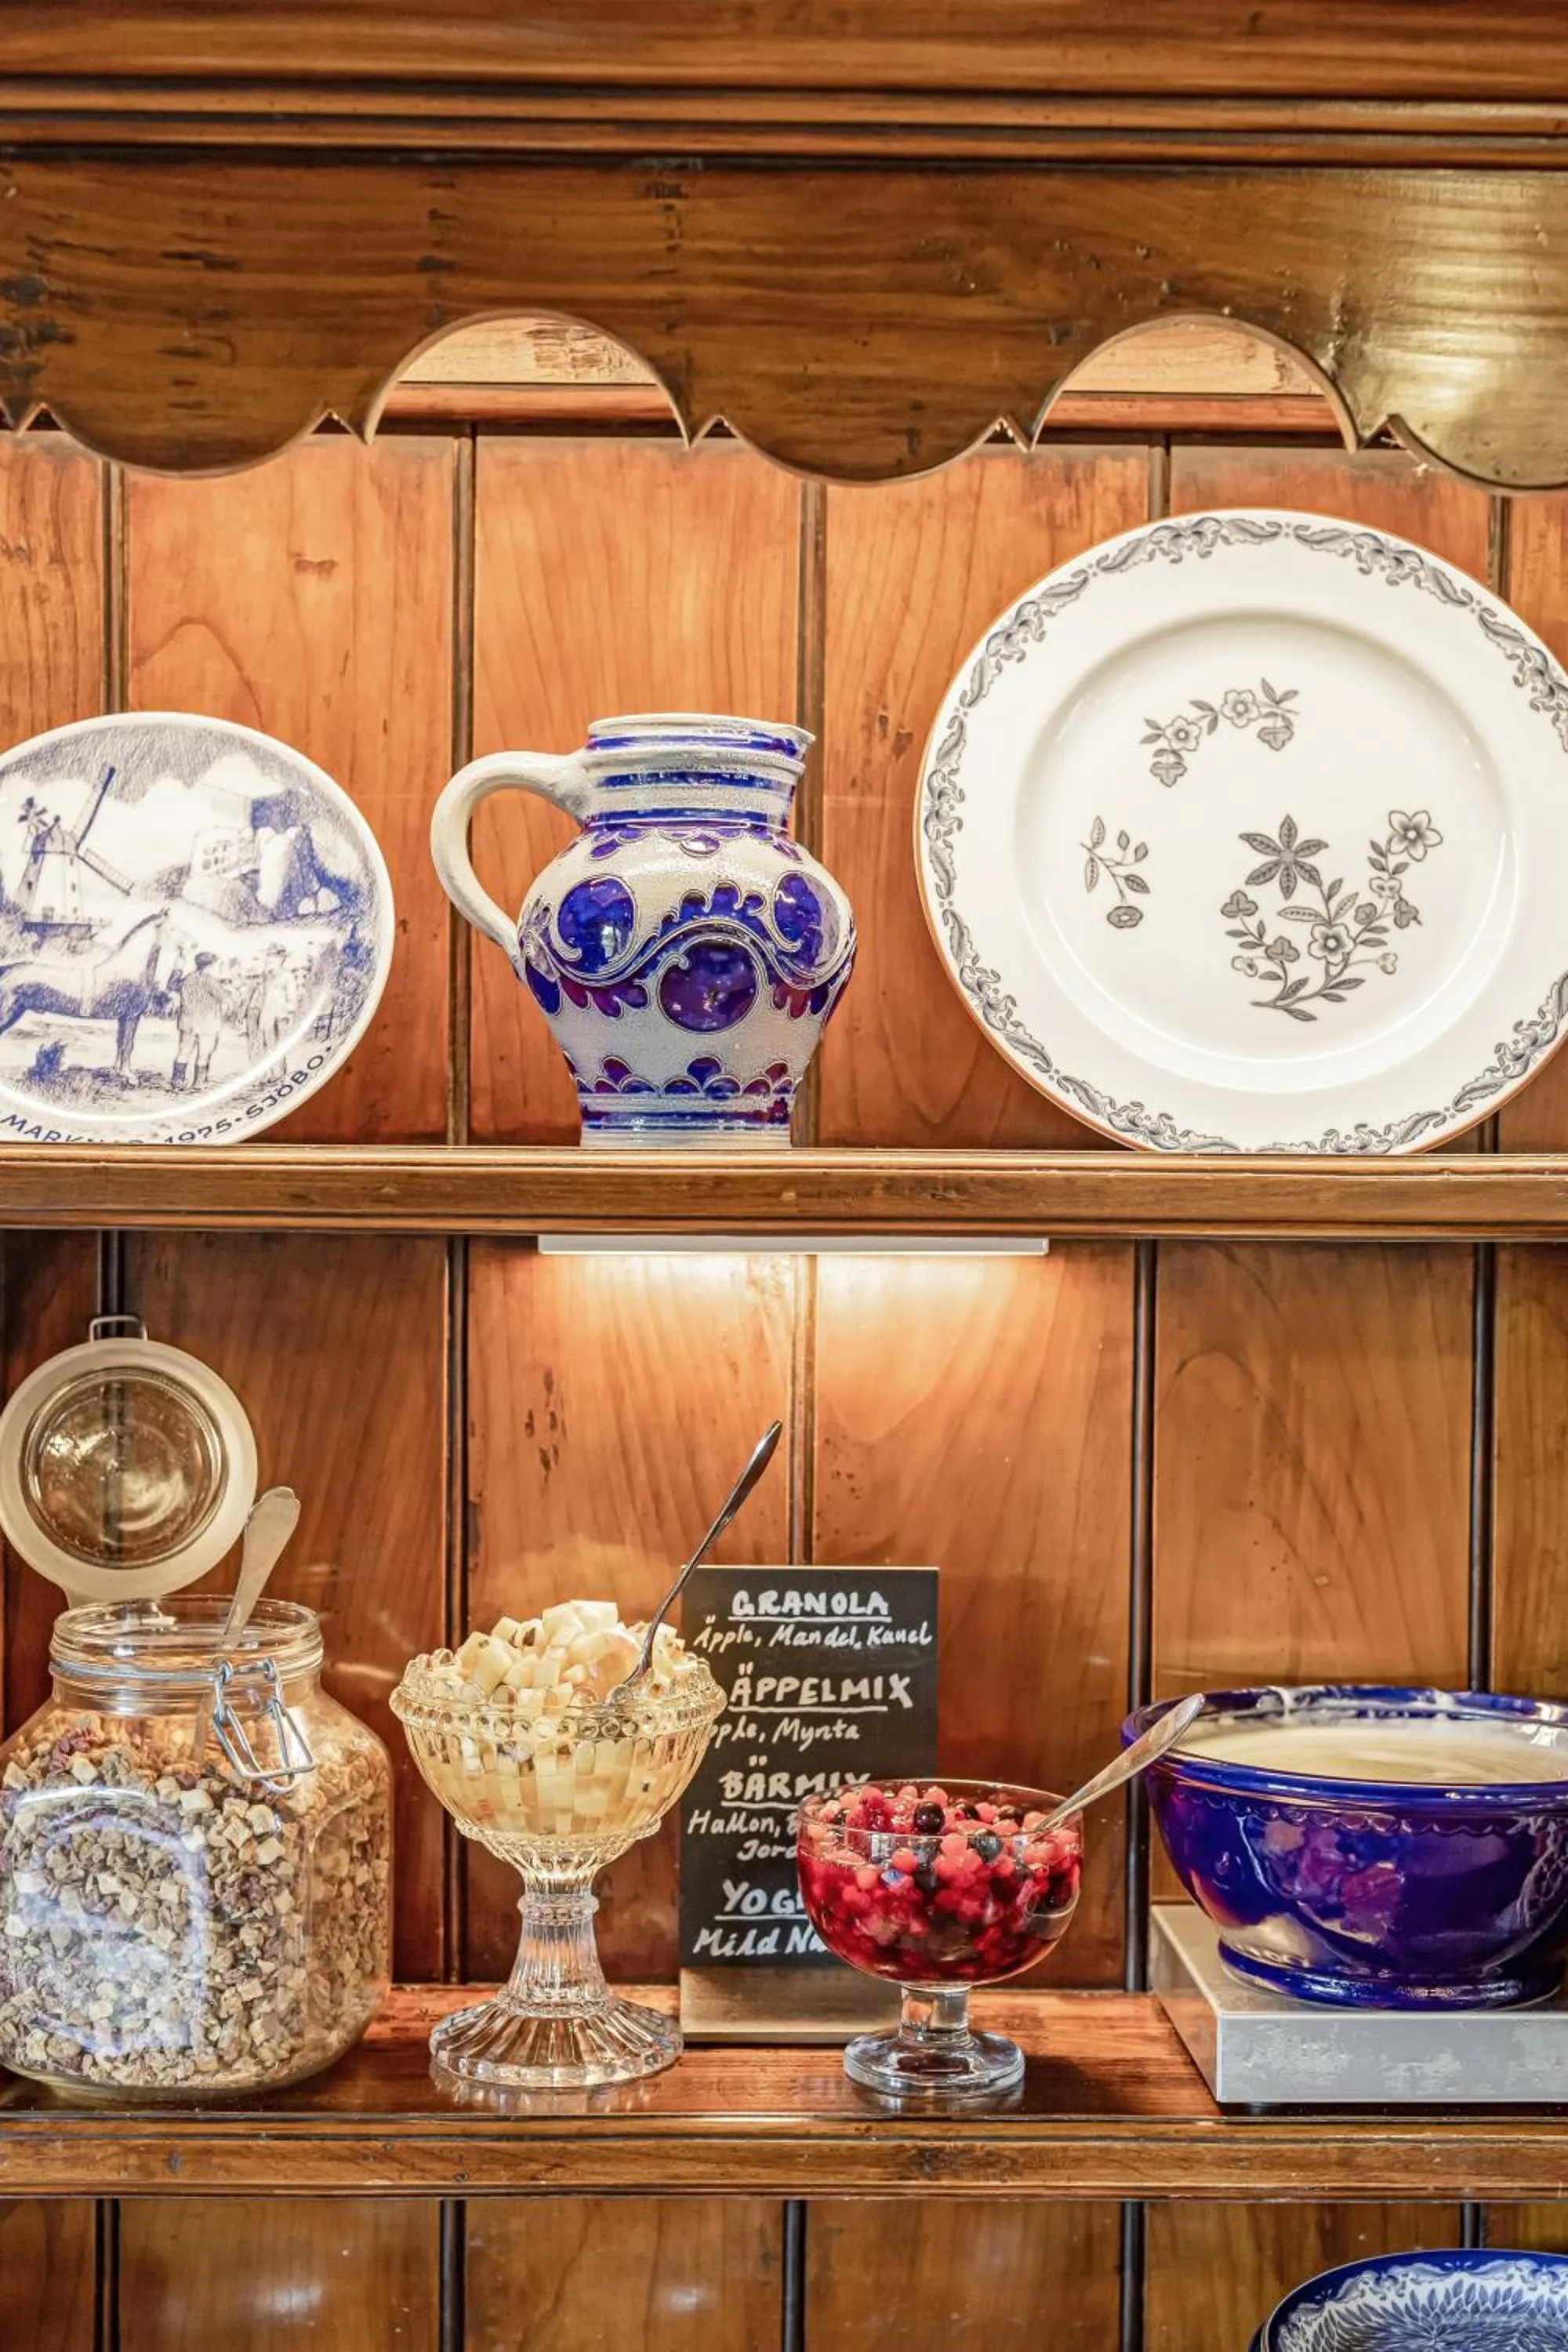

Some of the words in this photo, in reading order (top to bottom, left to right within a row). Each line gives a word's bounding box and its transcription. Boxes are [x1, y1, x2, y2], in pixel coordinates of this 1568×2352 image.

[731, 1590, 888, 1616] GRANOLA
[729, 1662, 913, 1708] ÄPPELMIX
[709, 1715, 766, 1749] pple,
[772, 1718, 860, 1752] Mynta
[692, 1927, 781, 1957] Mild
